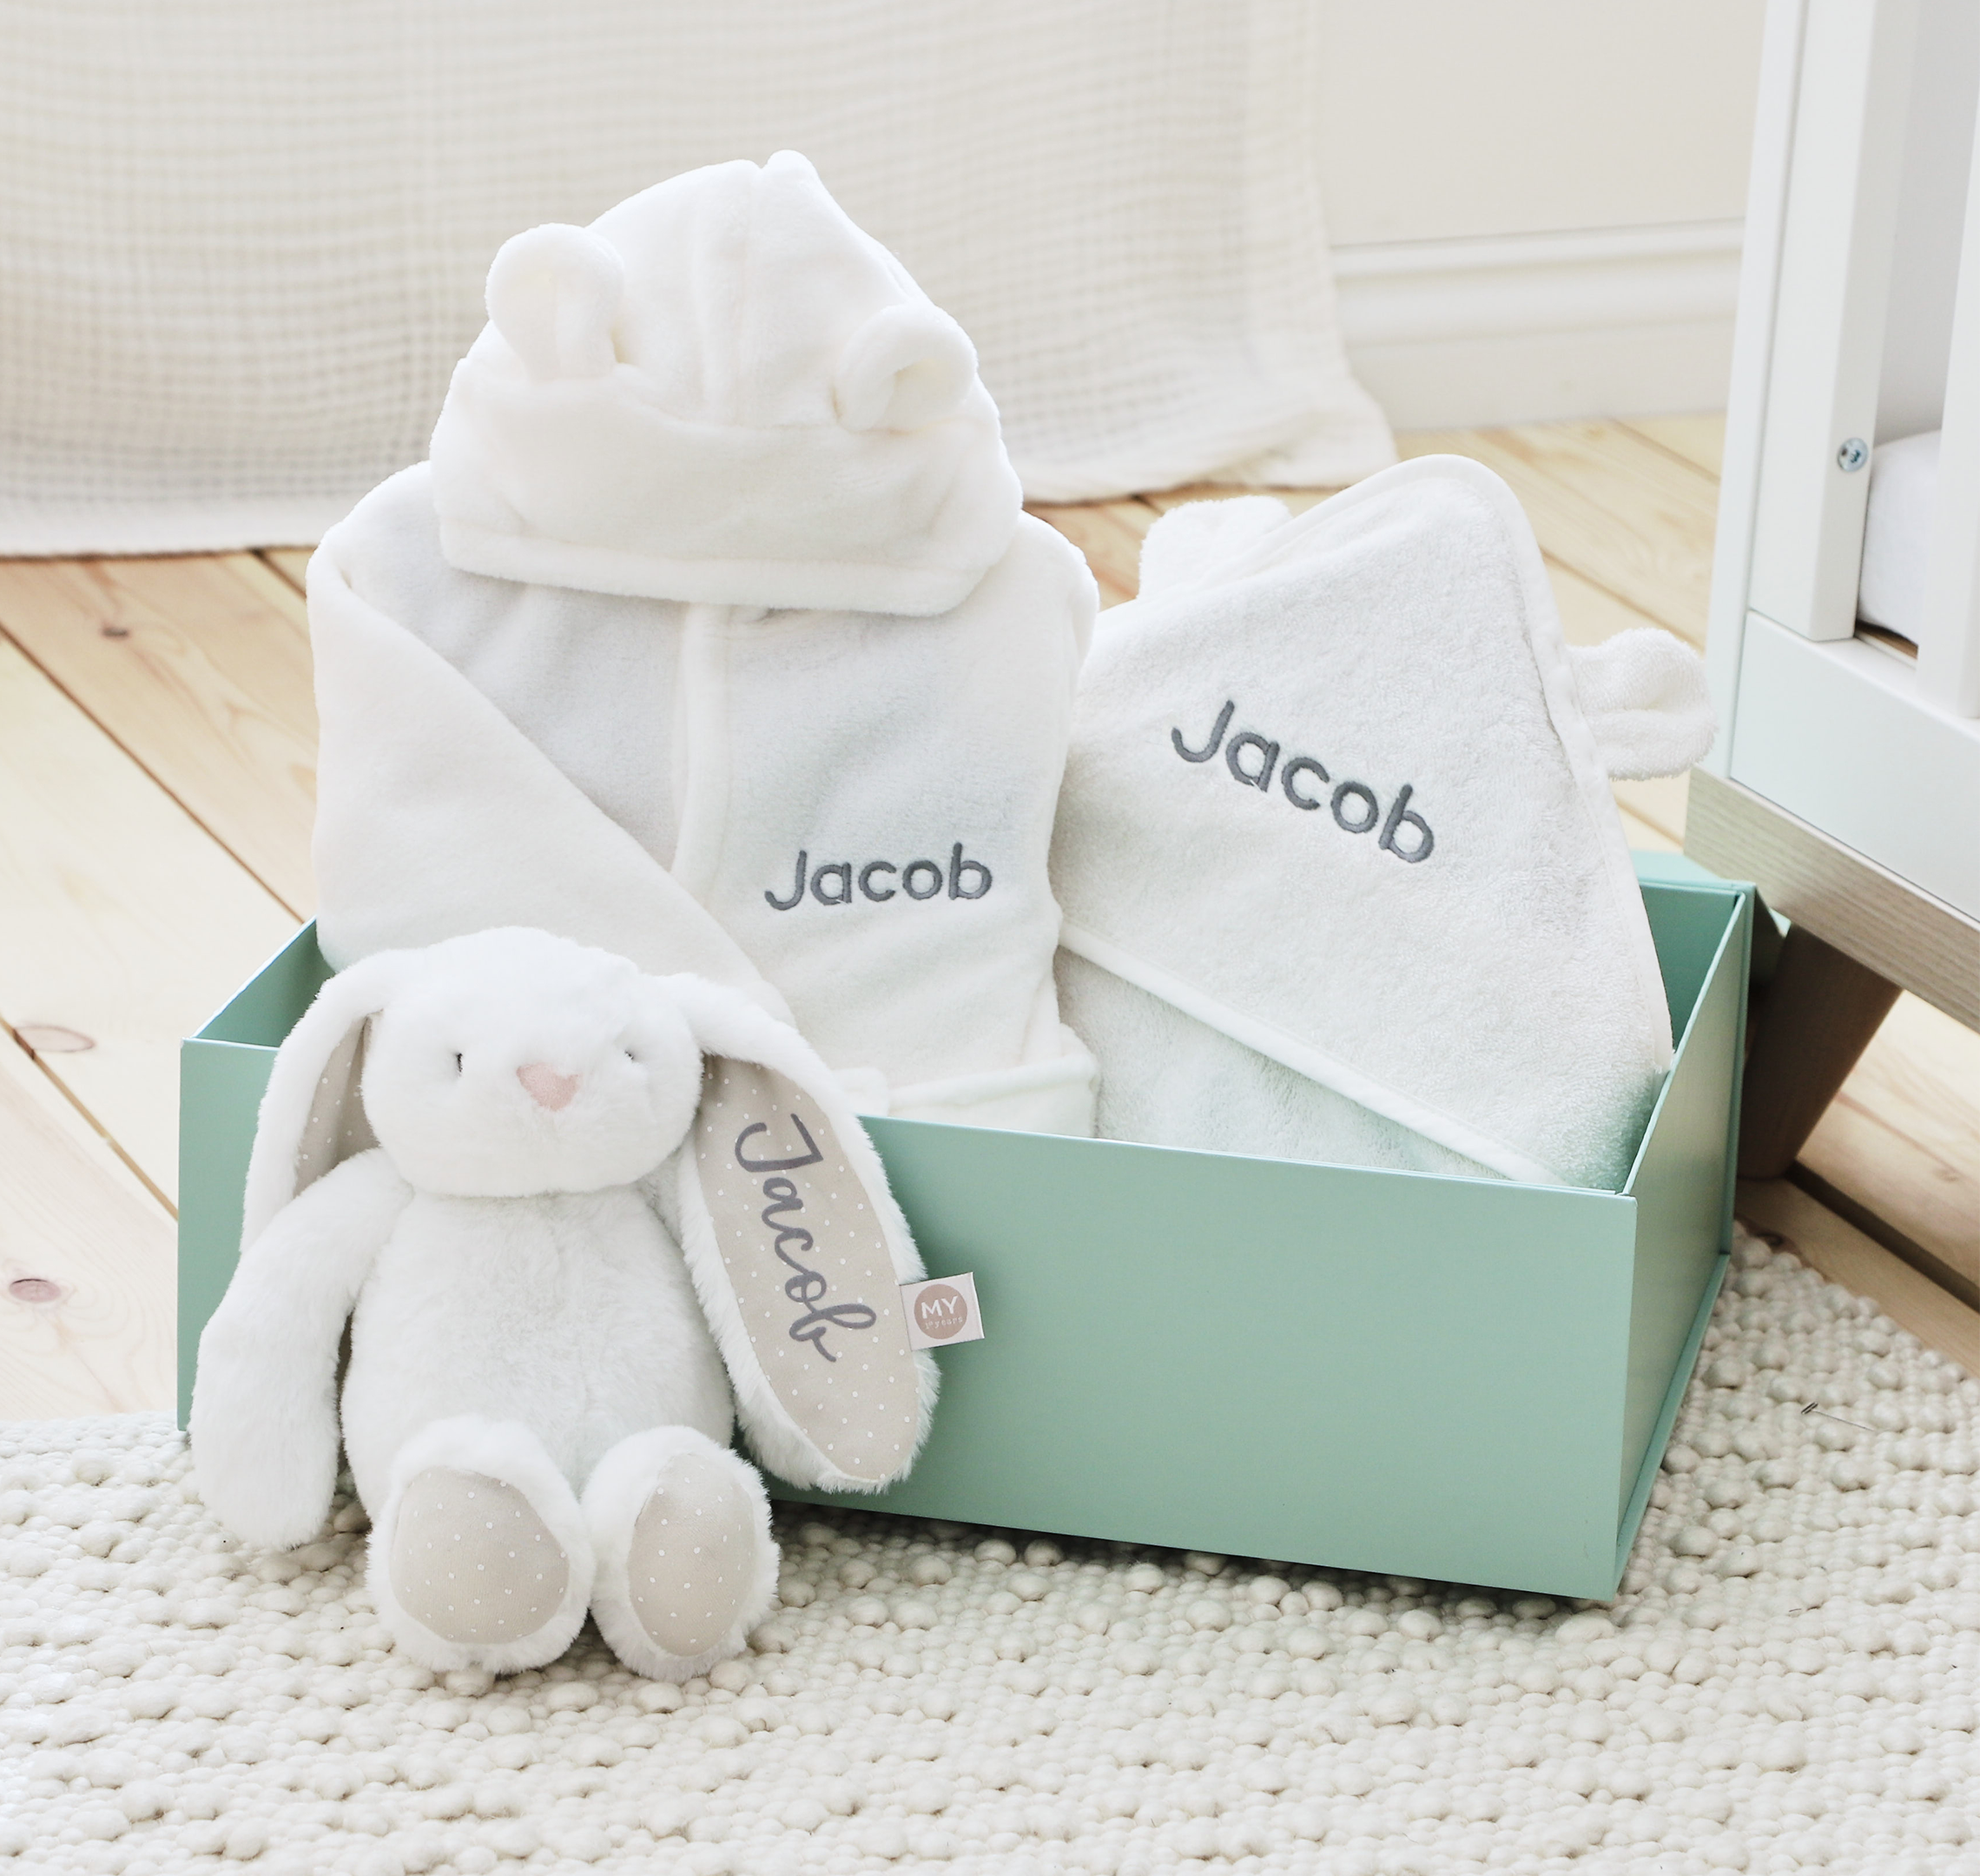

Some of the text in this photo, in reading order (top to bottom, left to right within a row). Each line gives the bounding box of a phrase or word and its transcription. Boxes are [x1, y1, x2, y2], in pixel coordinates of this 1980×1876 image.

[1172, 700, 1435, 863] Jacob
[764, 842, 993, 911] Jacob
[734, 1113, 877, 1363] Jacob
[921, 1295, 959, 1319] MY
